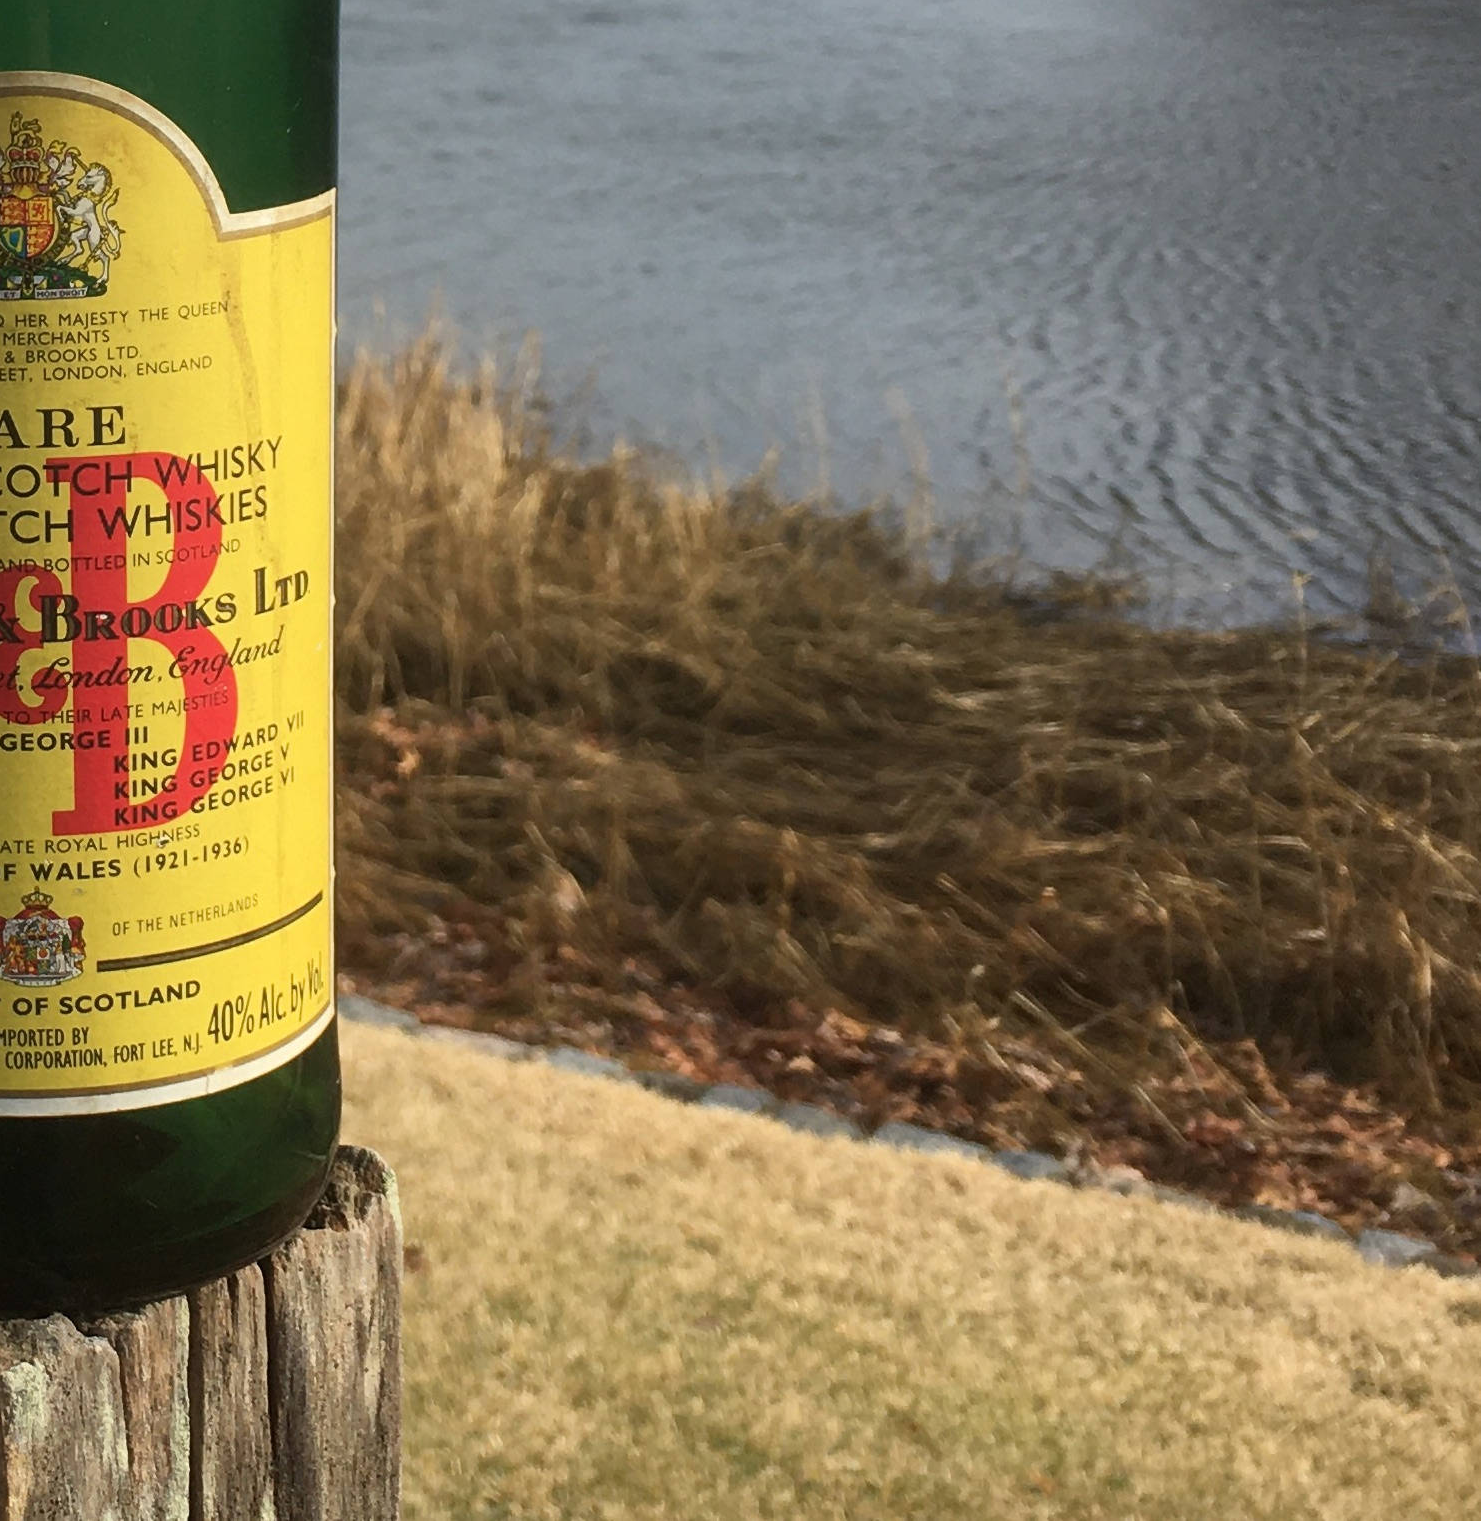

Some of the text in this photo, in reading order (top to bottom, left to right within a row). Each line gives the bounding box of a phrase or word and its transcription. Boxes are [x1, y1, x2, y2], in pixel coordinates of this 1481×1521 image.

[36, 290, 57, 298] MON
[15, 313, 49, 328] HER
[58, 310, 129, 330] MAJESTY
[139, 307, 169, 322] THE
[177, 301, 229, 320] QUEEN
[3, 329, 110, 347] MERCHANTS
[4, 350, 16, 364] &
[26, 347, 97, 364] BROOKS
[107, 345, 142, 361] LTD.
[43, 365, 127, 382] LONDON,
[136, 355, 213, 377] ENGLAND
[154, 435, 282, 490] WHISKY
[97, 485, 268, 540] WHISKIES
[44, 554, 126, 574] BOTTLED
[132, 553, 150, 567] IN
[156, 539, 241, 565] SCOTLAND
[38, 592, 237, 644] BROOKS
[31, 656, 162, 690] London,
[169, 624, 286, 686] England
[3, 709, 31, 725] TO
[39, 708, 92, 725] THEIR
[100, 703, 144, 723] LATE
[152, 691, 228, 718] MAJESTIES
[0, 729, 111, 752] GEORGE
[124, 726, 149, 746] III
[114, 710, 305, 774] KING EDWARD VII
[114, 742, 290, 800] KING GEORGE V
[114, 766, 295, 827] KING GEORGE VI
[45, 837, 108, 854] ROYAL
[118, 823, 201, 850] HIGHNESS
[30, 858, 121, 882] WALES
[133, 834, 250, 879] (1921-1936)
[112, 893, 259, 937] OF THE NETHERLANDS
[12, 997, 49, 1016] OF
[59, 979, 202, 1015] SCOTLAND
[207, 990, 255, 1045] 40%
[259, 983, 287, 1030] Alc.
[290, 972, 306, 1023] by
[5, 1047, 107, 1070] CORPORATION,
[113, 1041, 145, 1065] FORT
[152, 1037, 177, 1059] LEE,
[183, 1032, 203, 1056] N.J.
[72, 1027, 90, 1046] BY
